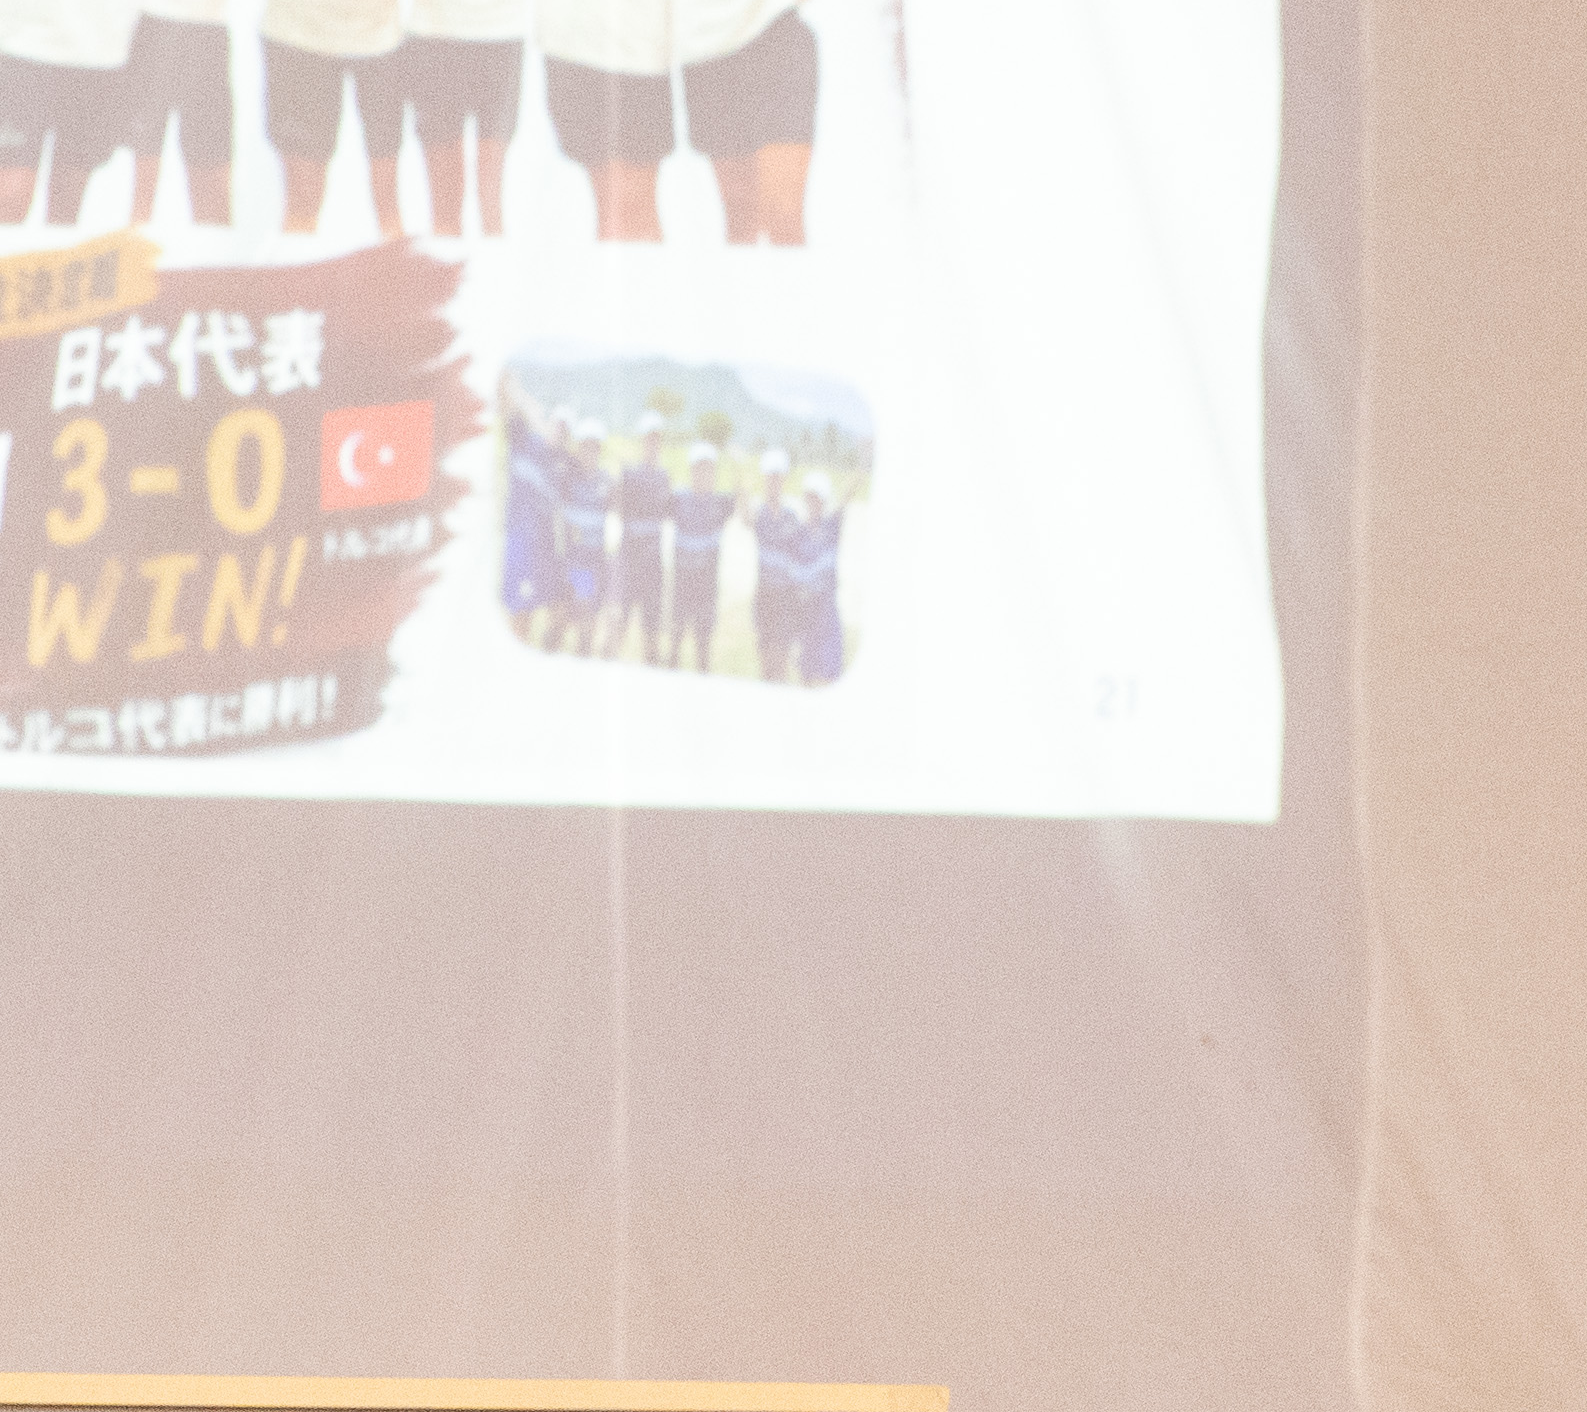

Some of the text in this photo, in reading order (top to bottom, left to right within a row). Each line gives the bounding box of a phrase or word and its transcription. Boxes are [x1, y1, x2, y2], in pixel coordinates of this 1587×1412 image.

[50, 310, 326, 412] 日本代表
[25, 533, 310, 673] WIN!
